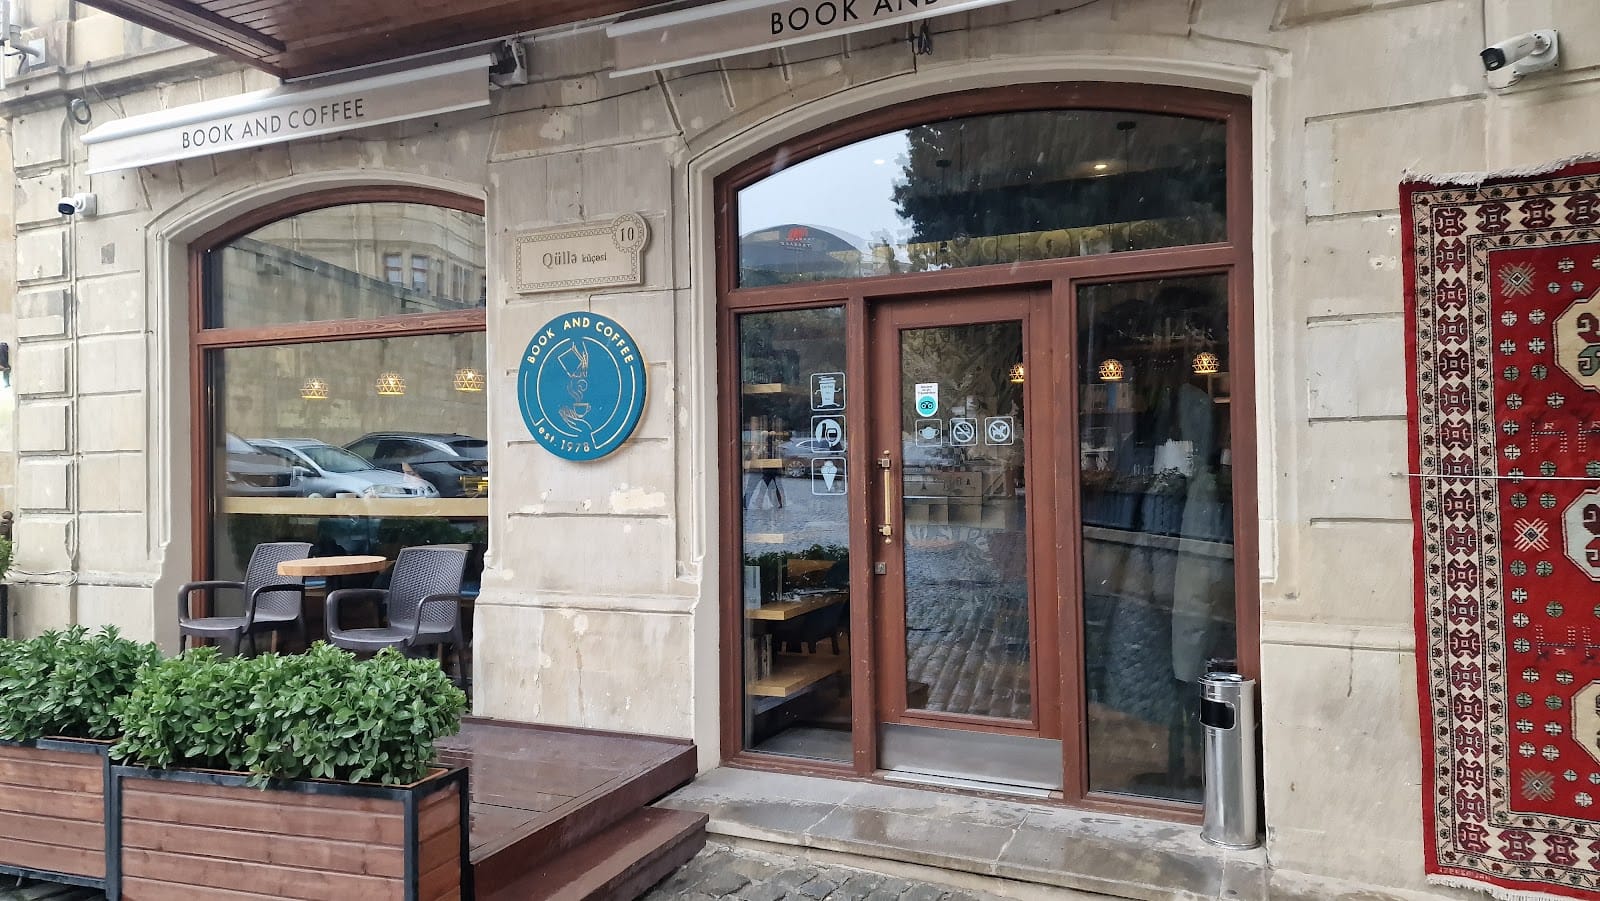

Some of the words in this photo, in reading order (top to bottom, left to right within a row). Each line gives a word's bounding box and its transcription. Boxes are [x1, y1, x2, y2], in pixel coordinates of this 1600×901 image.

[771, 0, 858, 34] BOOK
[182, 123, 234, 149] BOOK
[241, 115, 281, 139] AND
[288, 98, 365, 129] COFFEE
[620, 226, 635, 242] 10
[541, 250, 578, 269] Qüllə
[526, 327, 556, 364] BOOK
[563, 317, 591, 331] AND
[595, 322, 634, 364] COFFEE
[538, 426, 557, 447] est.
[560, 439, 591, 453] 1978
